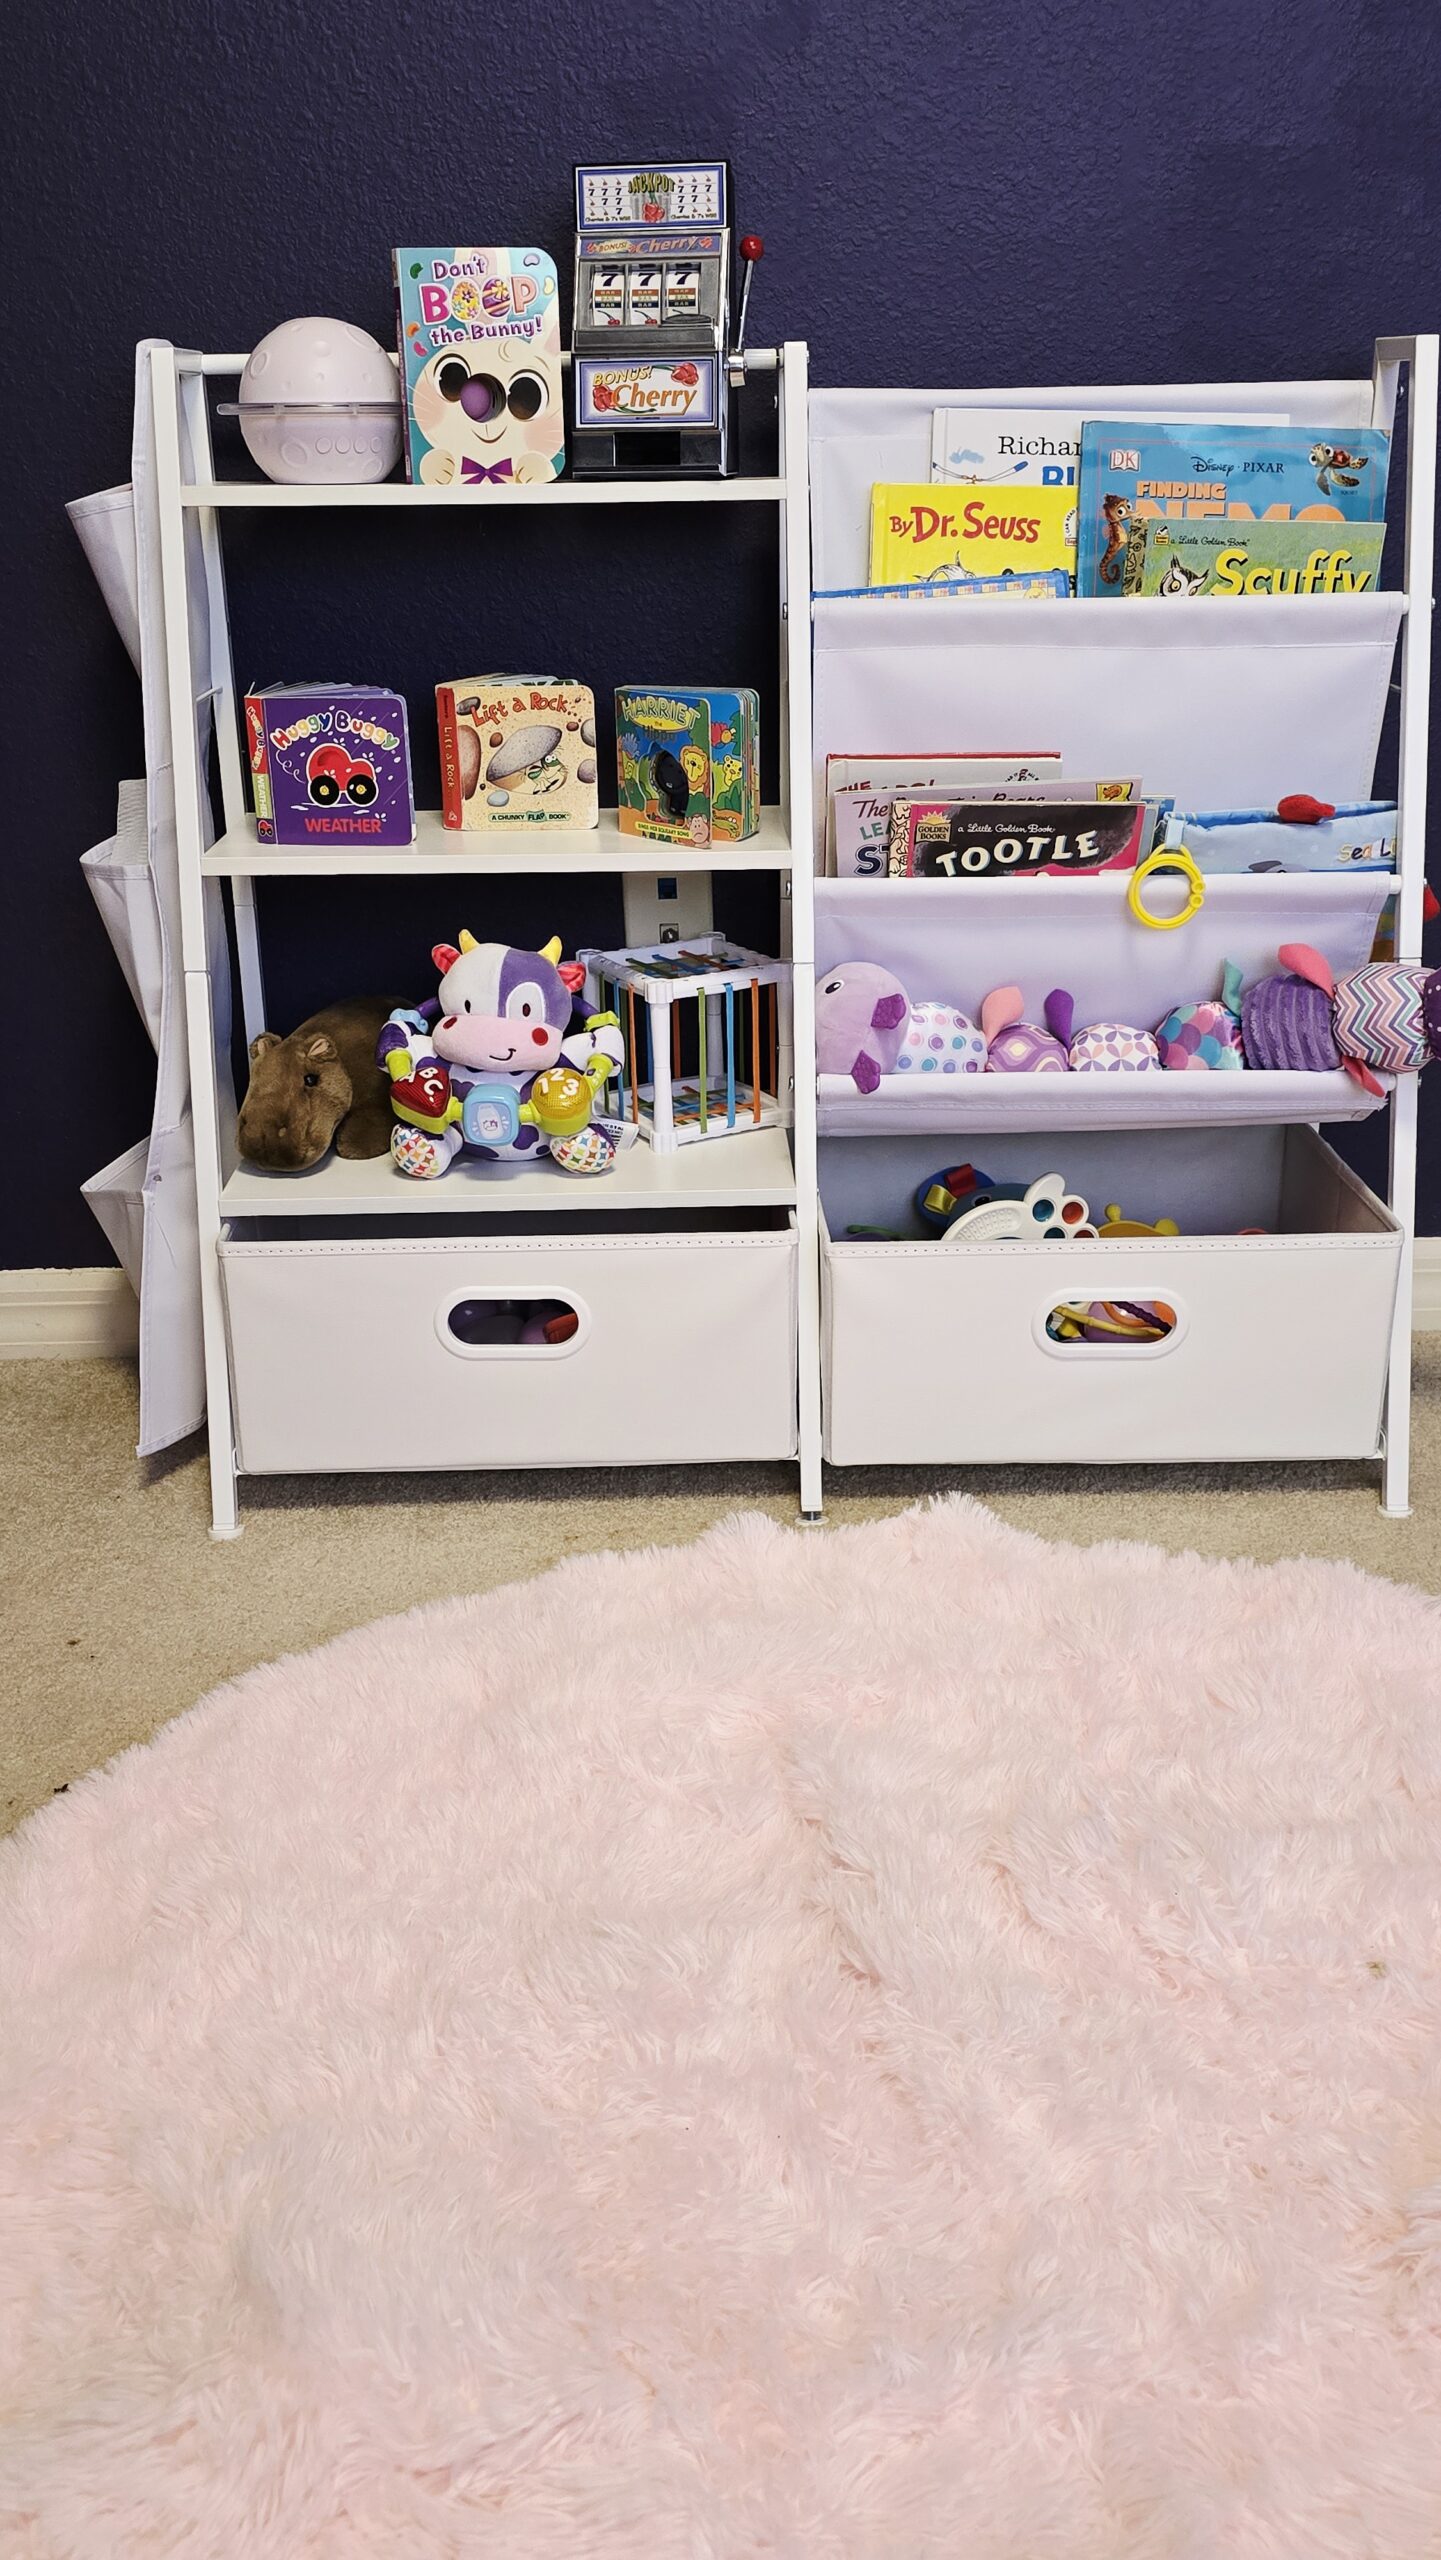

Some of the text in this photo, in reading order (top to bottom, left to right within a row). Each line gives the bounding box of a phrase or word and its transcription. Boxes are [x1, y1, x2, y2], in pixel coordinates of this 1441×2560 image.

[602, 188, 608, 196] 7
[615, 187, 622, 195] 7
[628, 173, 676, 193] JACKPOT
[705, 184, 712, 192] 7
[615, 197, 622, 205] 7
[678, 195, 685, 203] 7
[616, 207, 622, 215] 7
[678, 205, 685, 213] 7
[598, 236, 699, 254] BONUS! Cherry
[434, 256, 485, 280] Don't
[601, 271, 692, 287] 7 7 7
[421, 276, 538, 323] BOOP
[431, 315, 543, 345] the Bunny!
[593, 366, 653, 386] BONUS!
[613, 383, 698, 416] Cherry
[1111, 450, 1138, 468] DK
[1191, 456, 1284, 477] Disney PIXAR
[1136, 481, 1227, 500] FINDING
[889, 501, 1041, 543] By Dr. Seuss
[1178, 535, 1199, 545] Little
[1201, 536, 1226, 546] Golden
[1226, 538, 1248, 547] Book
[1210, 549, 1372, 595] Scuffy
[471, 700, 508, 727] Lift
[513, 697, 527, 712] a
[530, 692, 568, 713] Rock
[622, 696, 701, 730] HARRIET
[270, 709, 400, 750] Huggy Buggy
[445, 764, 455, 788] Rock
[257, 775, 267, 818] WEATHER
[528, 812, 545, 821] FLAP
[852, 799, 889, 818] The
[305, 817, 382, 833] WEATHER
[918, 825, 949, 833] GOLDEN
[967, 822, 993, 833] Little
[995, 823, 1027, 833] Golden
[1027, 824, 1053, 833] Book
[936, 829, 1100, 877] TOOTLE
[1337, 844, 1373, 861] Sea
